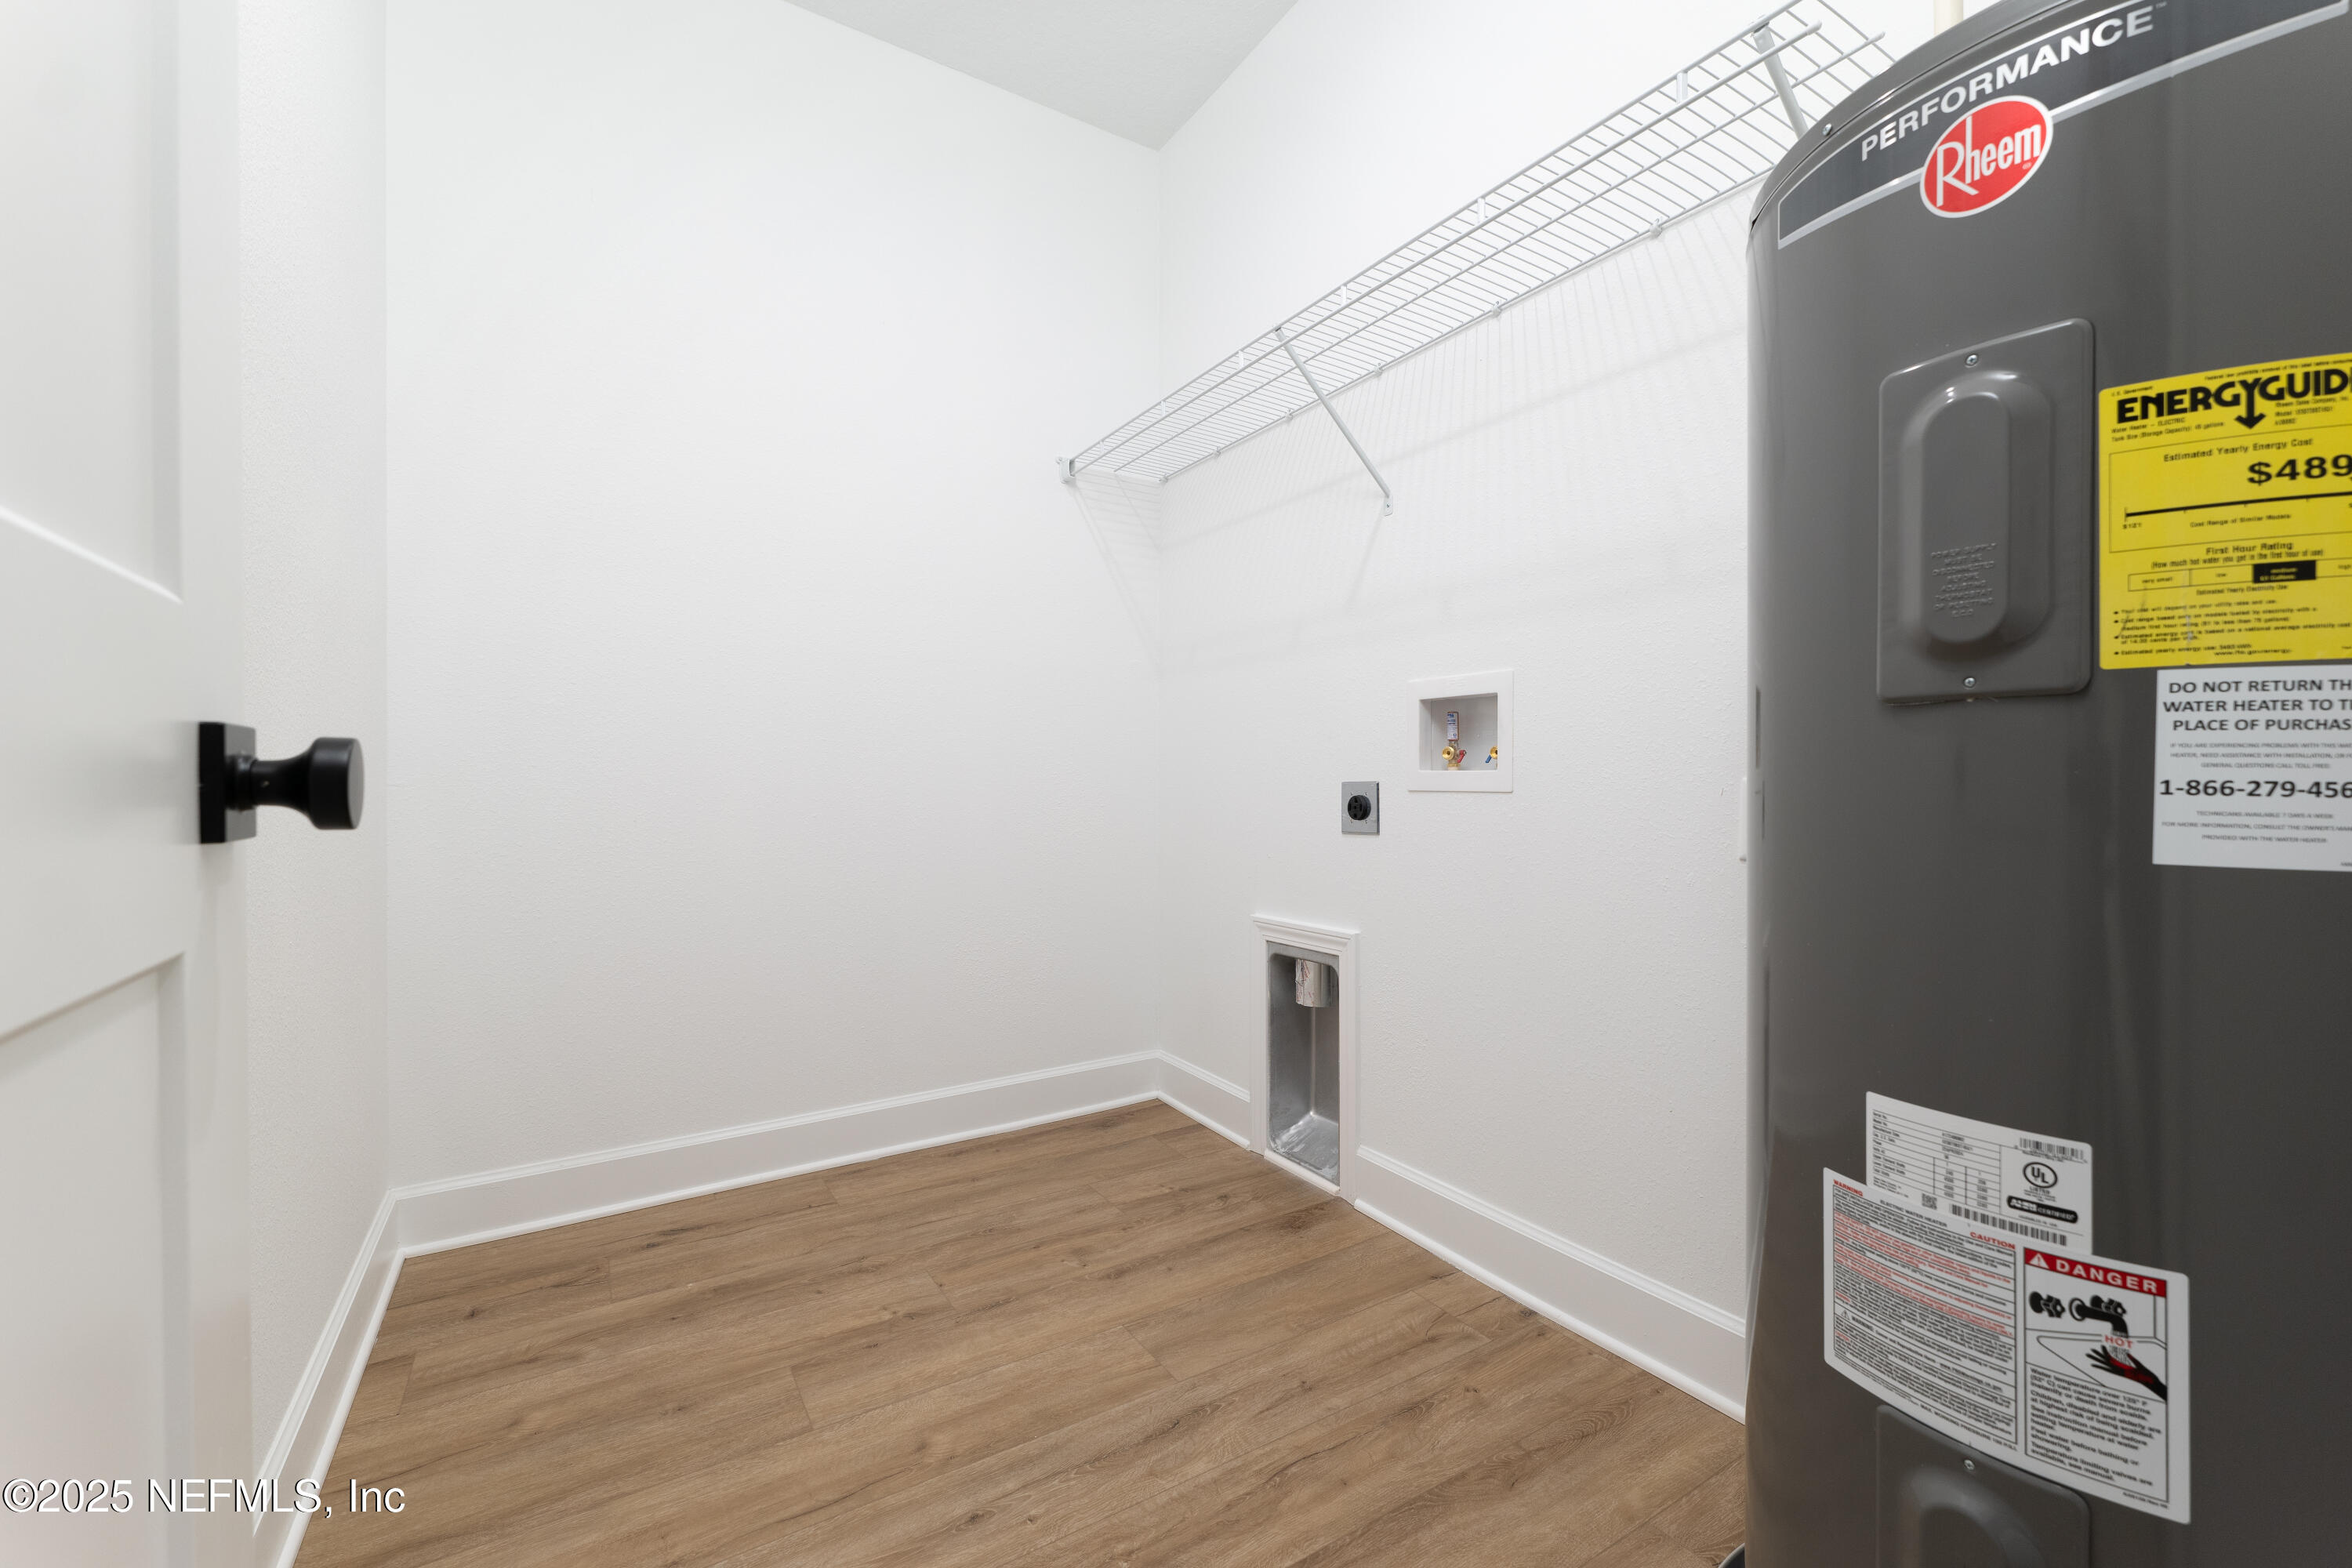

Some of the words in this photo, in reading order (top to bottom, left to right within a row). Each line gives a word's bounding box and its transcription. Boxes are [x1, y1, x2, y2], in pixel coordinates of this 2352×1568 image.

[1861, 6, 2154, 162] PERFORMANCE
[1936, 115, 2042, 208] Rheem
[2117, 368, 2352, 429] ENERGYGUID
[2164, 450, 2212, 462] Estimated
[2216, 445, 2249, 455] Yearly
[2253, 441, 2287, 451] Energy
[2247, 455, 2352, 485] $489
[2169, 682, 2196, 693] DO
[2203, 681, 2242, 692] NOT
[2249, 680, 2322, 691] RETURN
[2164, 701, 2227, 712] WATER
[2233, 699, 2303, 711] HEATER
[2310, 699, 2332, 710] TO
[2173, 720, 2228, 731] PLACE
[2235, 719, 2259, 730] OF
[2266, 719, 2352, 730] PURCHAS
[2160, 779, 2352, 798] 1-866-279-456
[1833, 1179, 1863, 1196] WARNING
[1969, 1232, 2015, 1250] CAUTION
[2056, 1259, 2158, 1294] DANGER
[2104, 1334, 2132, 1348] HOT
